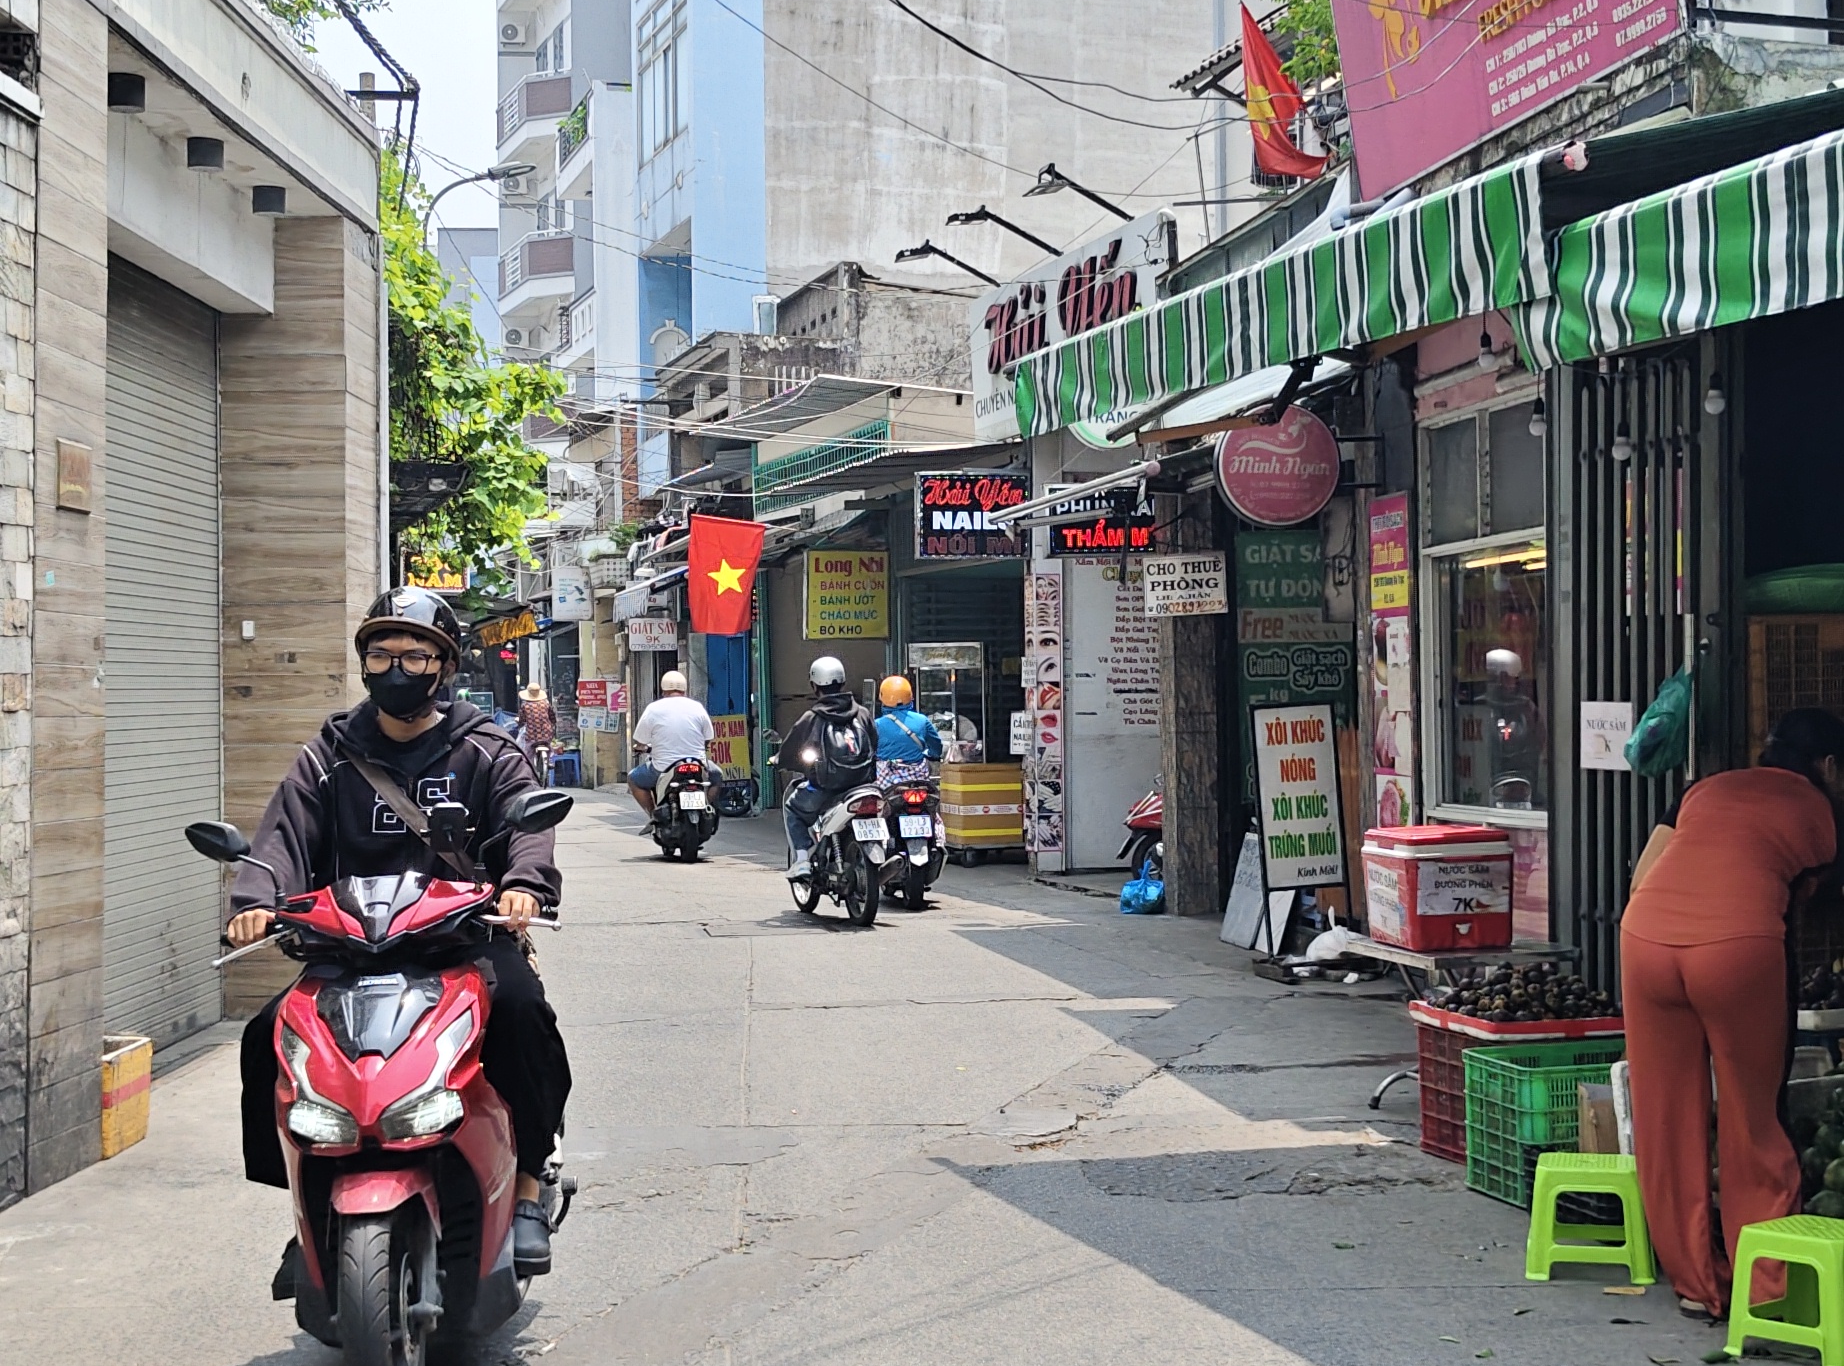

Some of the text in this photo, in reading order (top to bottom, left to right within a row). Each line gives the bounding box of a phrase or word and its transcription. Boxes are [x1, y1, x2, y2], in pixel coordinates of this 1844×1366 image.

[1229, 455, 1281, 475] Minh
[923, 479, 972, 506] Hải
[927, 531, 976, 555] NỐI
[1062, 518, 1126, 548] THẨM
[1245, 539, 1295, 568] GIẶT
[814, 556, 853, 577] Long
[1146, 562, 1177, 576] CHO
[820, 579, 851, 591] BÁNH
[1149, 576, 1220, 592] PHÒNG
[1246, 573, 1322, 602] TỰ ĐỘN
[820, 594, 851, 606] BÁNH
[820, 608, 851, 621] CHÁO
[1240, 610, 1284, 639] Free
[645, 635, 661, 644] 9K
[838, 625, 863, 635] KHO
[1249, 653, 1288, 676] Combo
[1269, 687, 1289, 703] kg
[1265, 714, 1326, 746] XÔI KHÚC
[710, 741, 732, 764] 50K
[1279, 753, 1317, 783] NÓNG
[1271, 789, 1329, 822] XÔI KHÚC
[1268, 823, 1337, 860] TRỨNG MUỐI
[1438, 864, 1466, 877] NƯỚC
[1452, 897, 1475, 912] 7K
